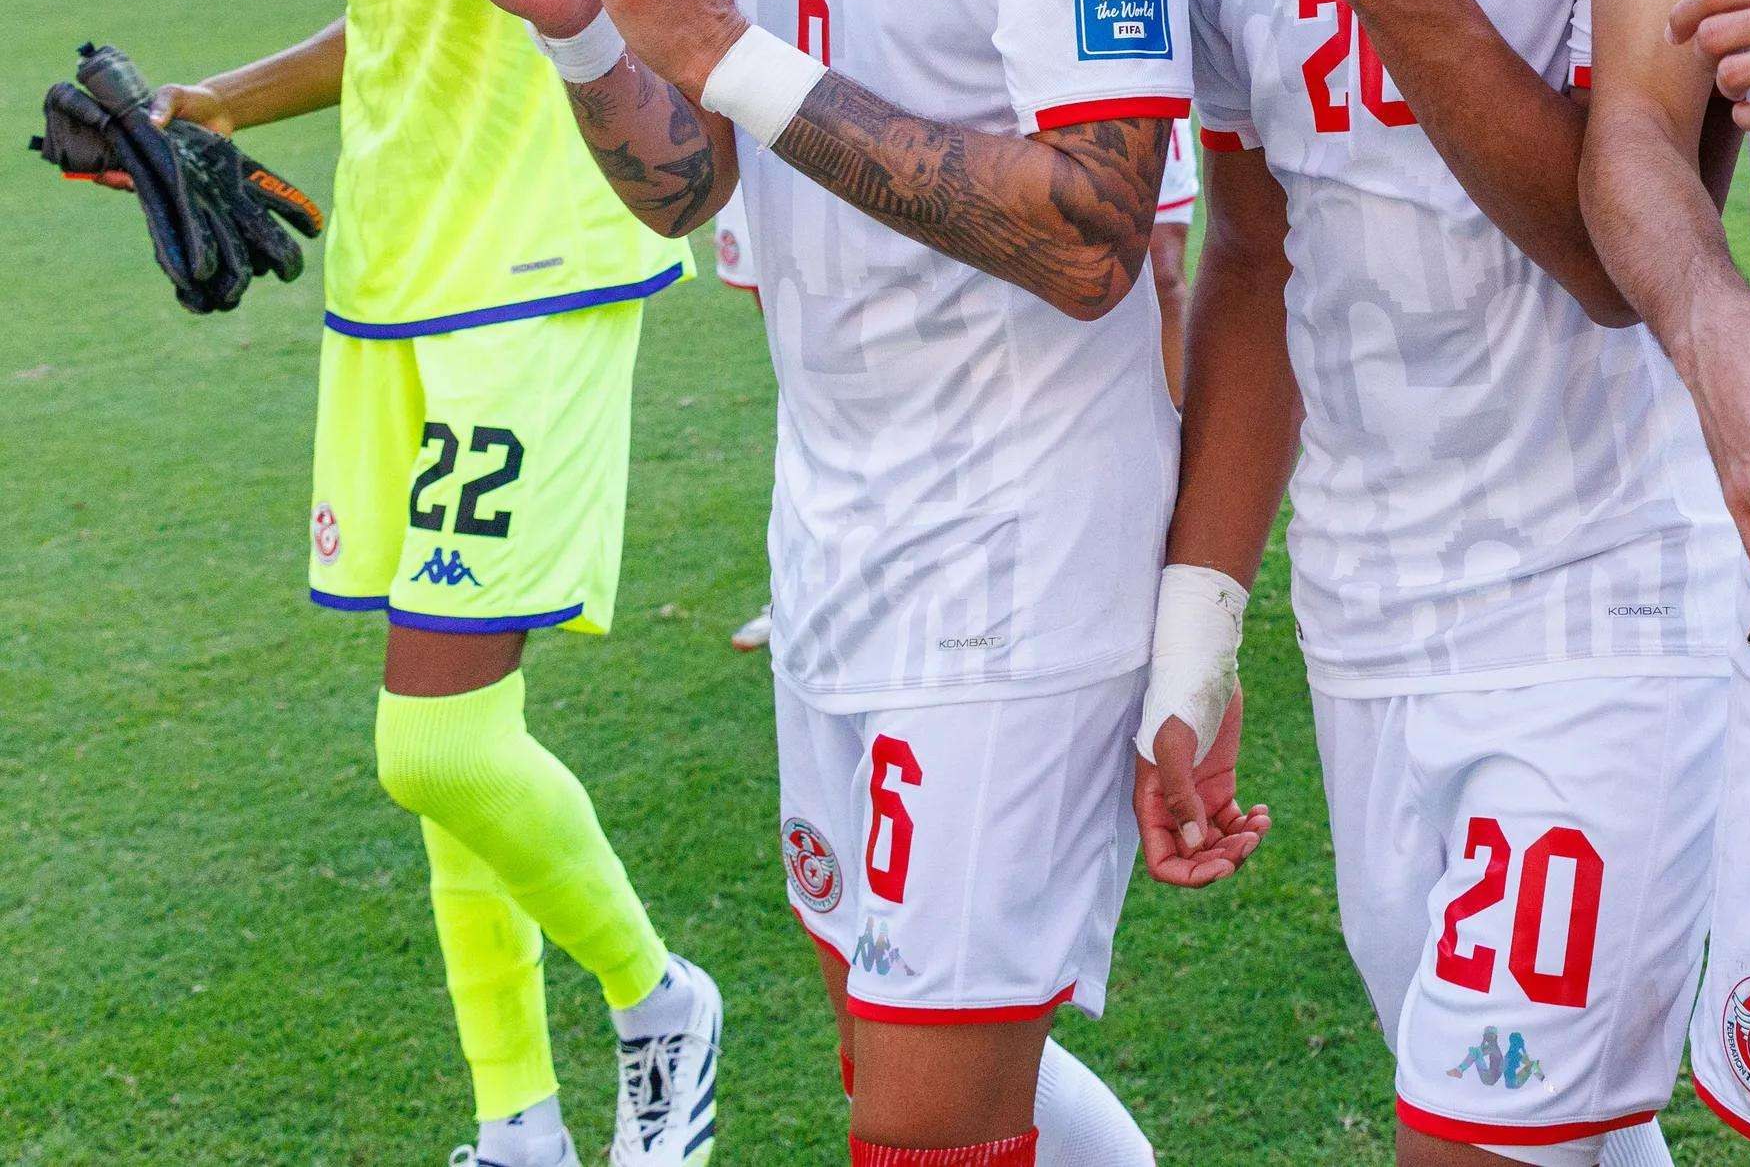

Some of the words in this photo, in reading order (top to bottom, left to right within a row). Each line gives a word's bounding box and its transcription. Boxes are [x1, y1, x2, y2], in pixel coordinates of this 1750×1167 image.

[1095, 2, 1119, 20] the
[1121, 1, 1154, 20] World
[1118, 25, 1141, 35] FIFA
[410, 421, 524, 538] 22
[1608, 607, 1671, 615] KOMBAT
[939, 637, 994, 648] KOMBAT
[866, 733, 923, 904] 6
[1436, 817, 1604, 1008] 20
[1727, 1020, 1747, 1075] FEDERATION
